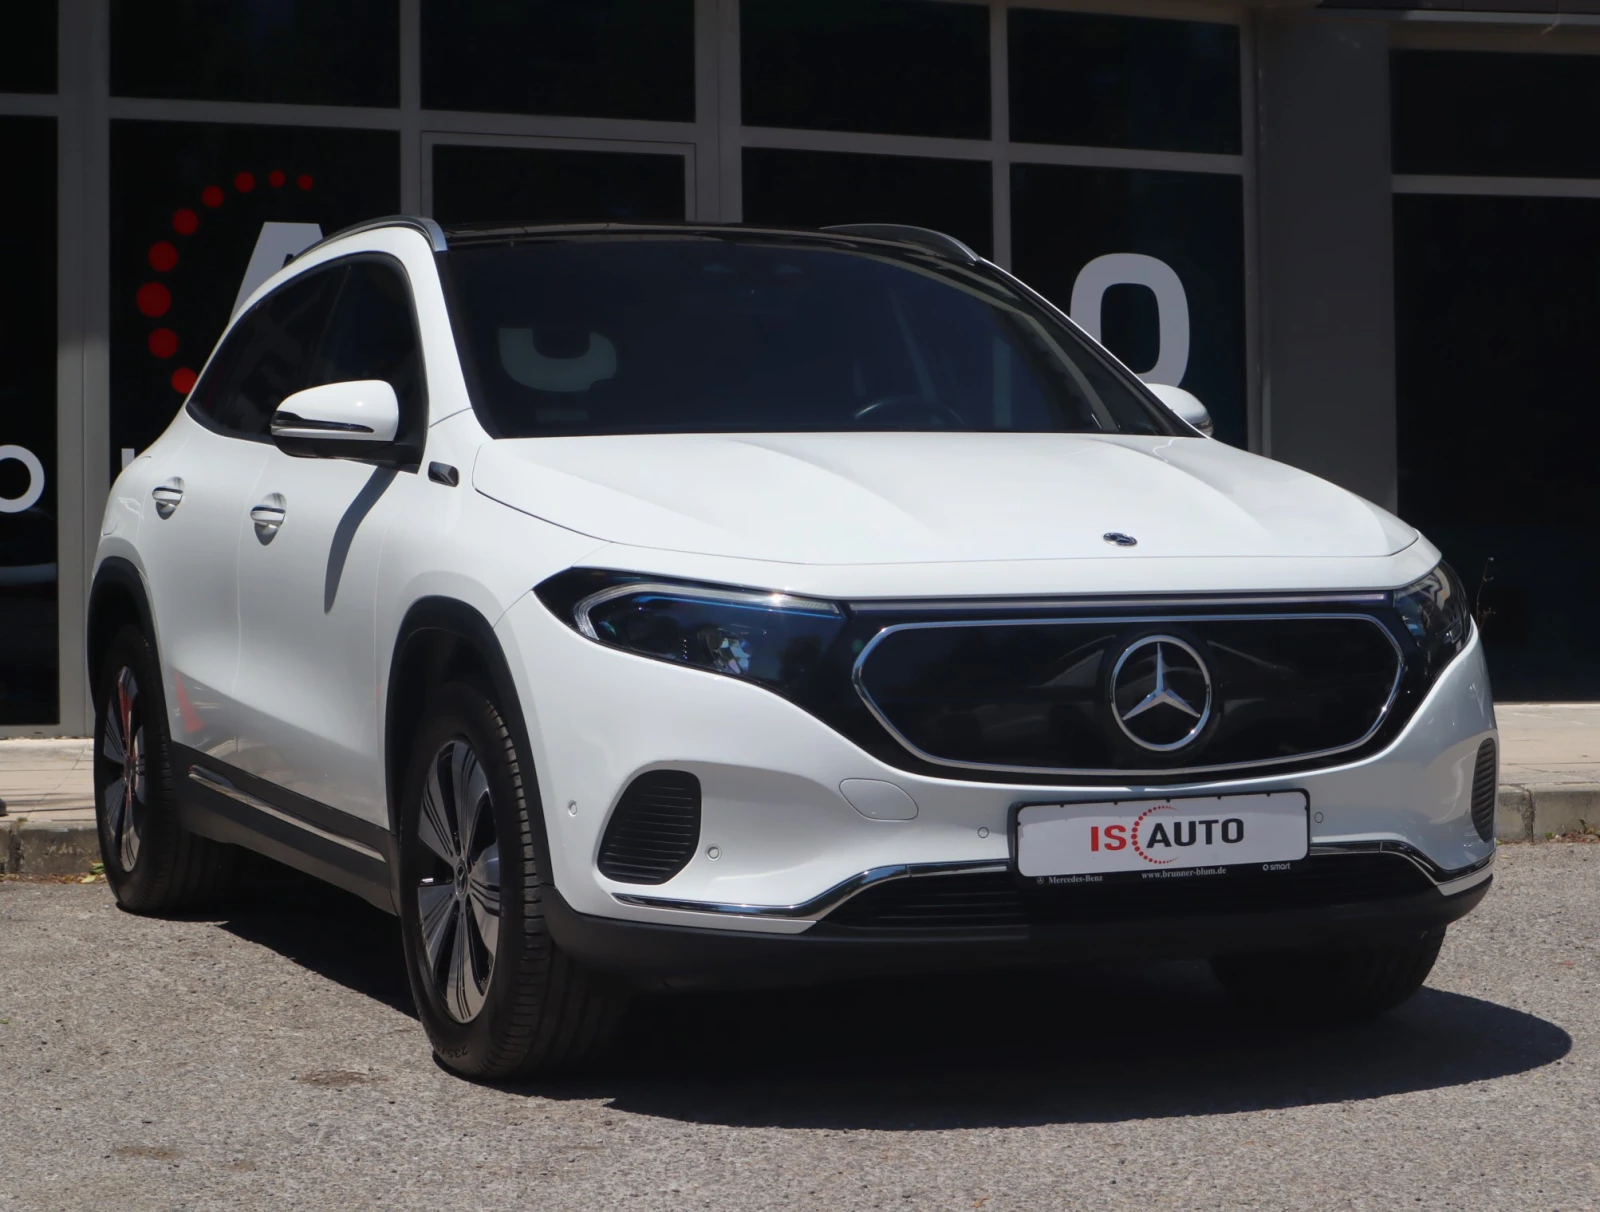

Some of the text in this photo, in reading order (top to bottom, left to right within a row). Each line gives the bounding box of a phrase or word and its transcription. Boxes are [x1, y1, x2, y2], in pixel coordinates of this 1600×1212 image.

[1090, 818, 1244, 852] IS AUTO
[1270, 862, 1291, 871] smart
[1141, 866, 1227, 879] www.brunner-blum.de
[1048, 874, 1104, 884] Mercedes-Benz
